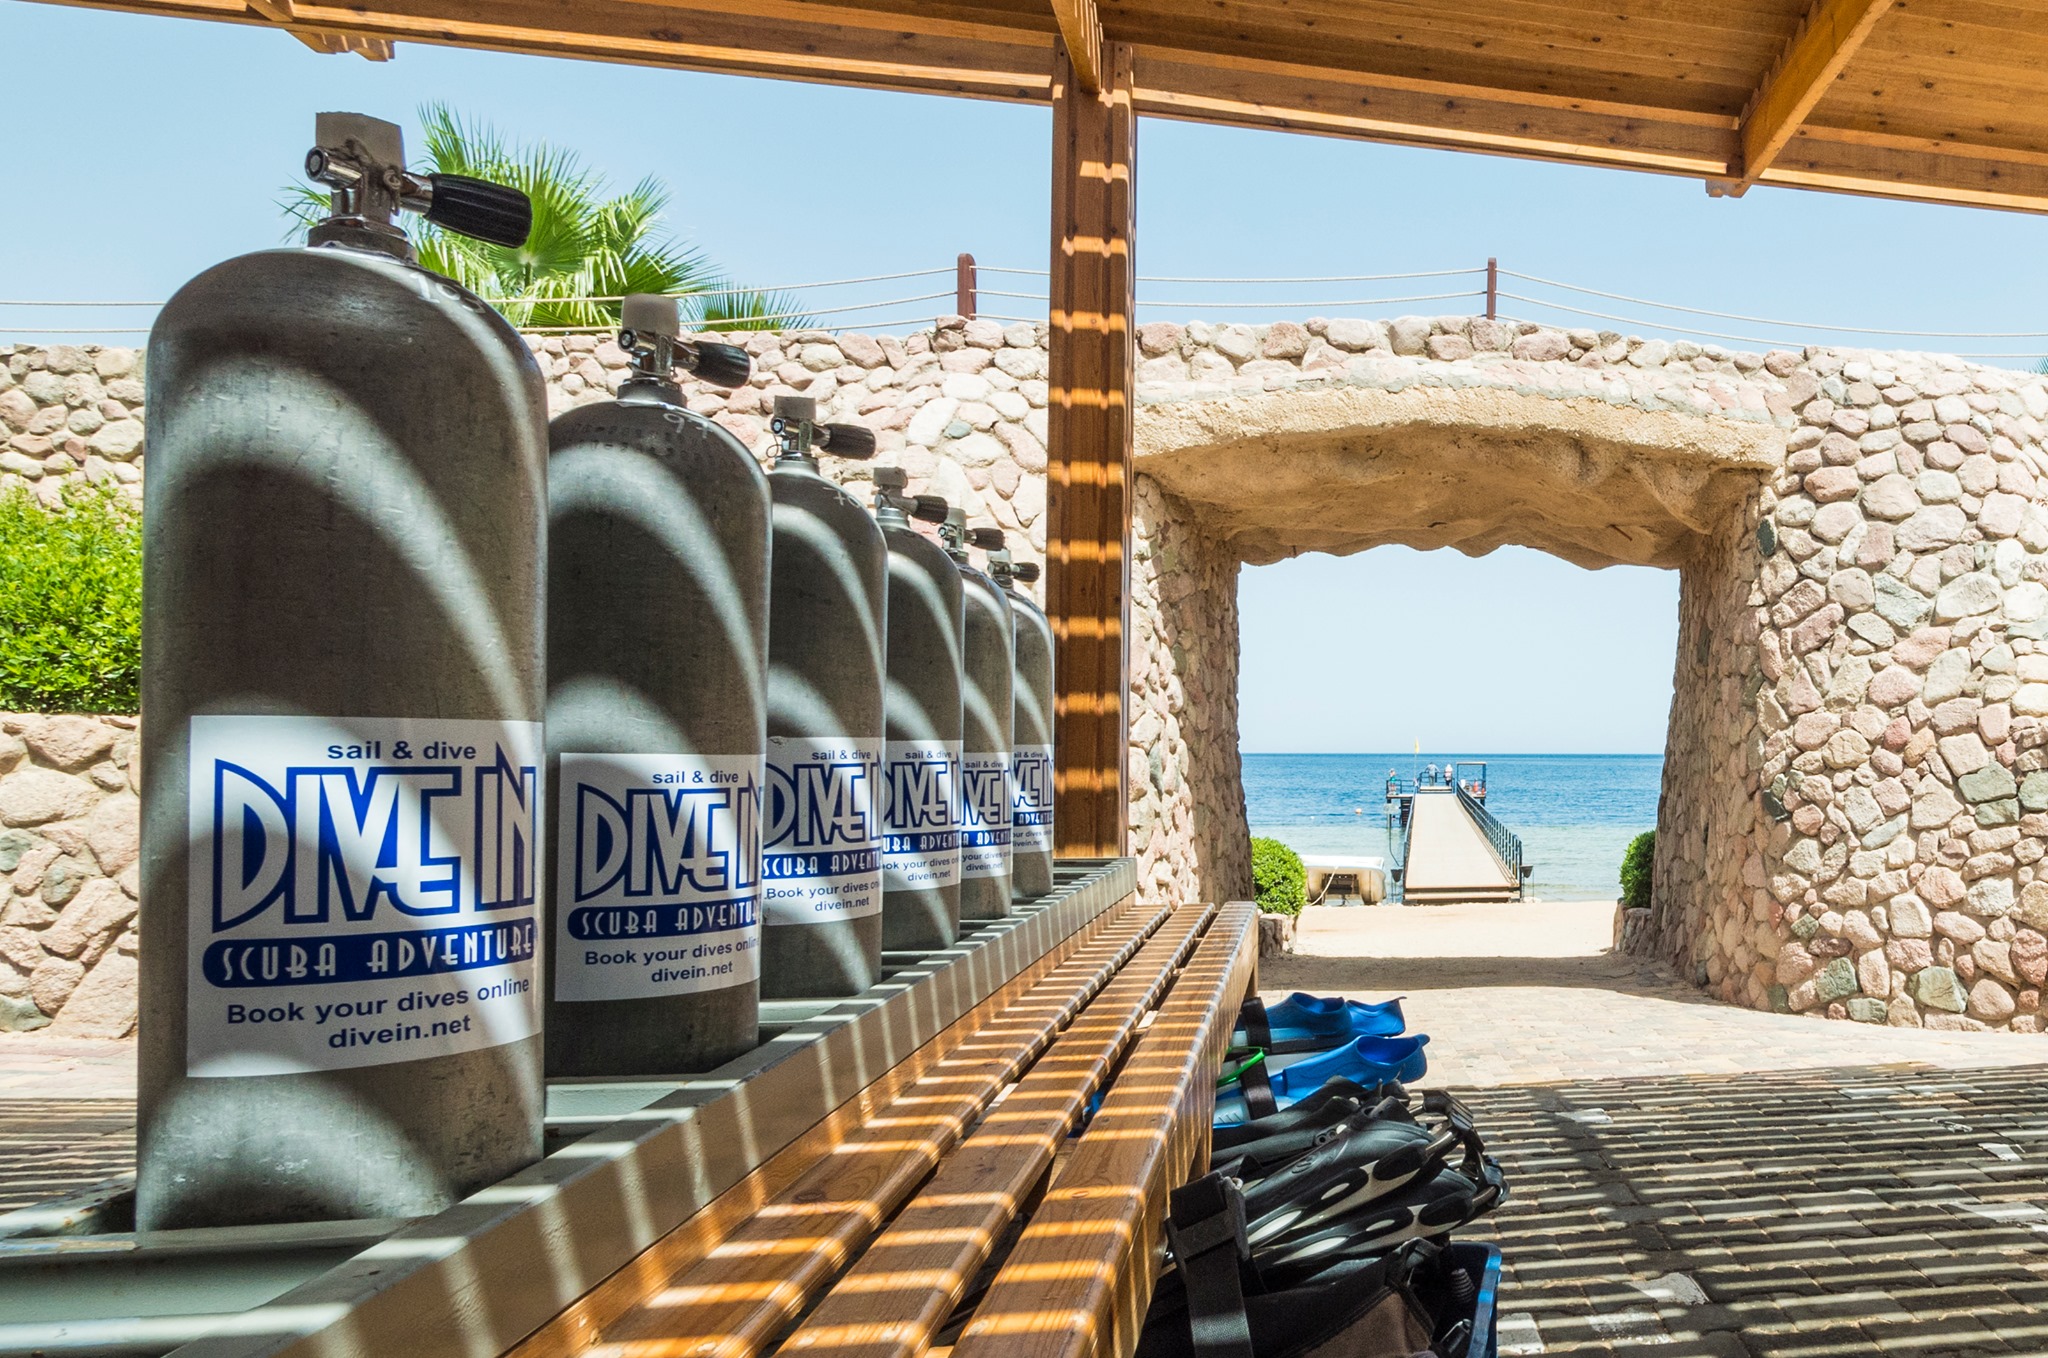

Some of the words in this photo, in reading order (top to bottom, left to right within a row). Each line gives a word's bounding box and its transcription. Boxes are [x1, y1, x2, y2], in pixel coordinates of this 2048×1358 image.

[663, 412, 714, 439] 97
[327, 741, 381, 760] sail
[392, 741, 413, 760] &
[423, 741, 477, 760] dive
[812, 750, 835, 760] sail
[839, 749, 848, 760] &
[852, 749, 871, 760] dive
[905, 750, 924, 760] sail
[927, 750, 934, 759] &
[936, 749, 952, 760] dive
[965, 761, 980, 769] sail
[652, 771, 685, 784] sail
[692, 770, 704, 784] &
[710, 770, 739, 784] dive
[1013, 759, 1040, 808] VE
[764, 761, 866, 850] DIVE
[961, 769, 1001, 826] VE
[212, 758, 462, 934] DIVE
[474, 741, 537, 912] IN
[575, 782, 731, 903] DIVE
[883, 836, 911, 852] UBA
[763, 856, 819, 877] SCUBA
[883, 862, 899, 870] ok
[903, 862, 928, 872] your
[930, 857, 950, 867] dives
[962, 853, 982, 863] your
[907, 870, 951, 882] divein.net
[766, 888, 803, 899] Book
[809, 886, 840, 899] your
[842, 881, 869, 894] dives
[815, 897, 870, 912] divein.net
[582, 910, 657, 936] SCUBA
[674, 901, 758, 932] ADVENTU
[222, 943, 337, 981] SCUBA
[366, 923, 533, 973] ADVENTURE
[585, 950, 637, 966] Book
[643, 949, 688, 966] your
[692, 938, 733, 958] dives
[651, 961, 734, 983] divein.net
[227, 1002, 305, 1024] Book
[315, 999, 388, 1024] your
[397, 989, 469, 1012] dives
[477, 978, 530, 1002] online
[328, 1015, 472, 1049] divein.net
